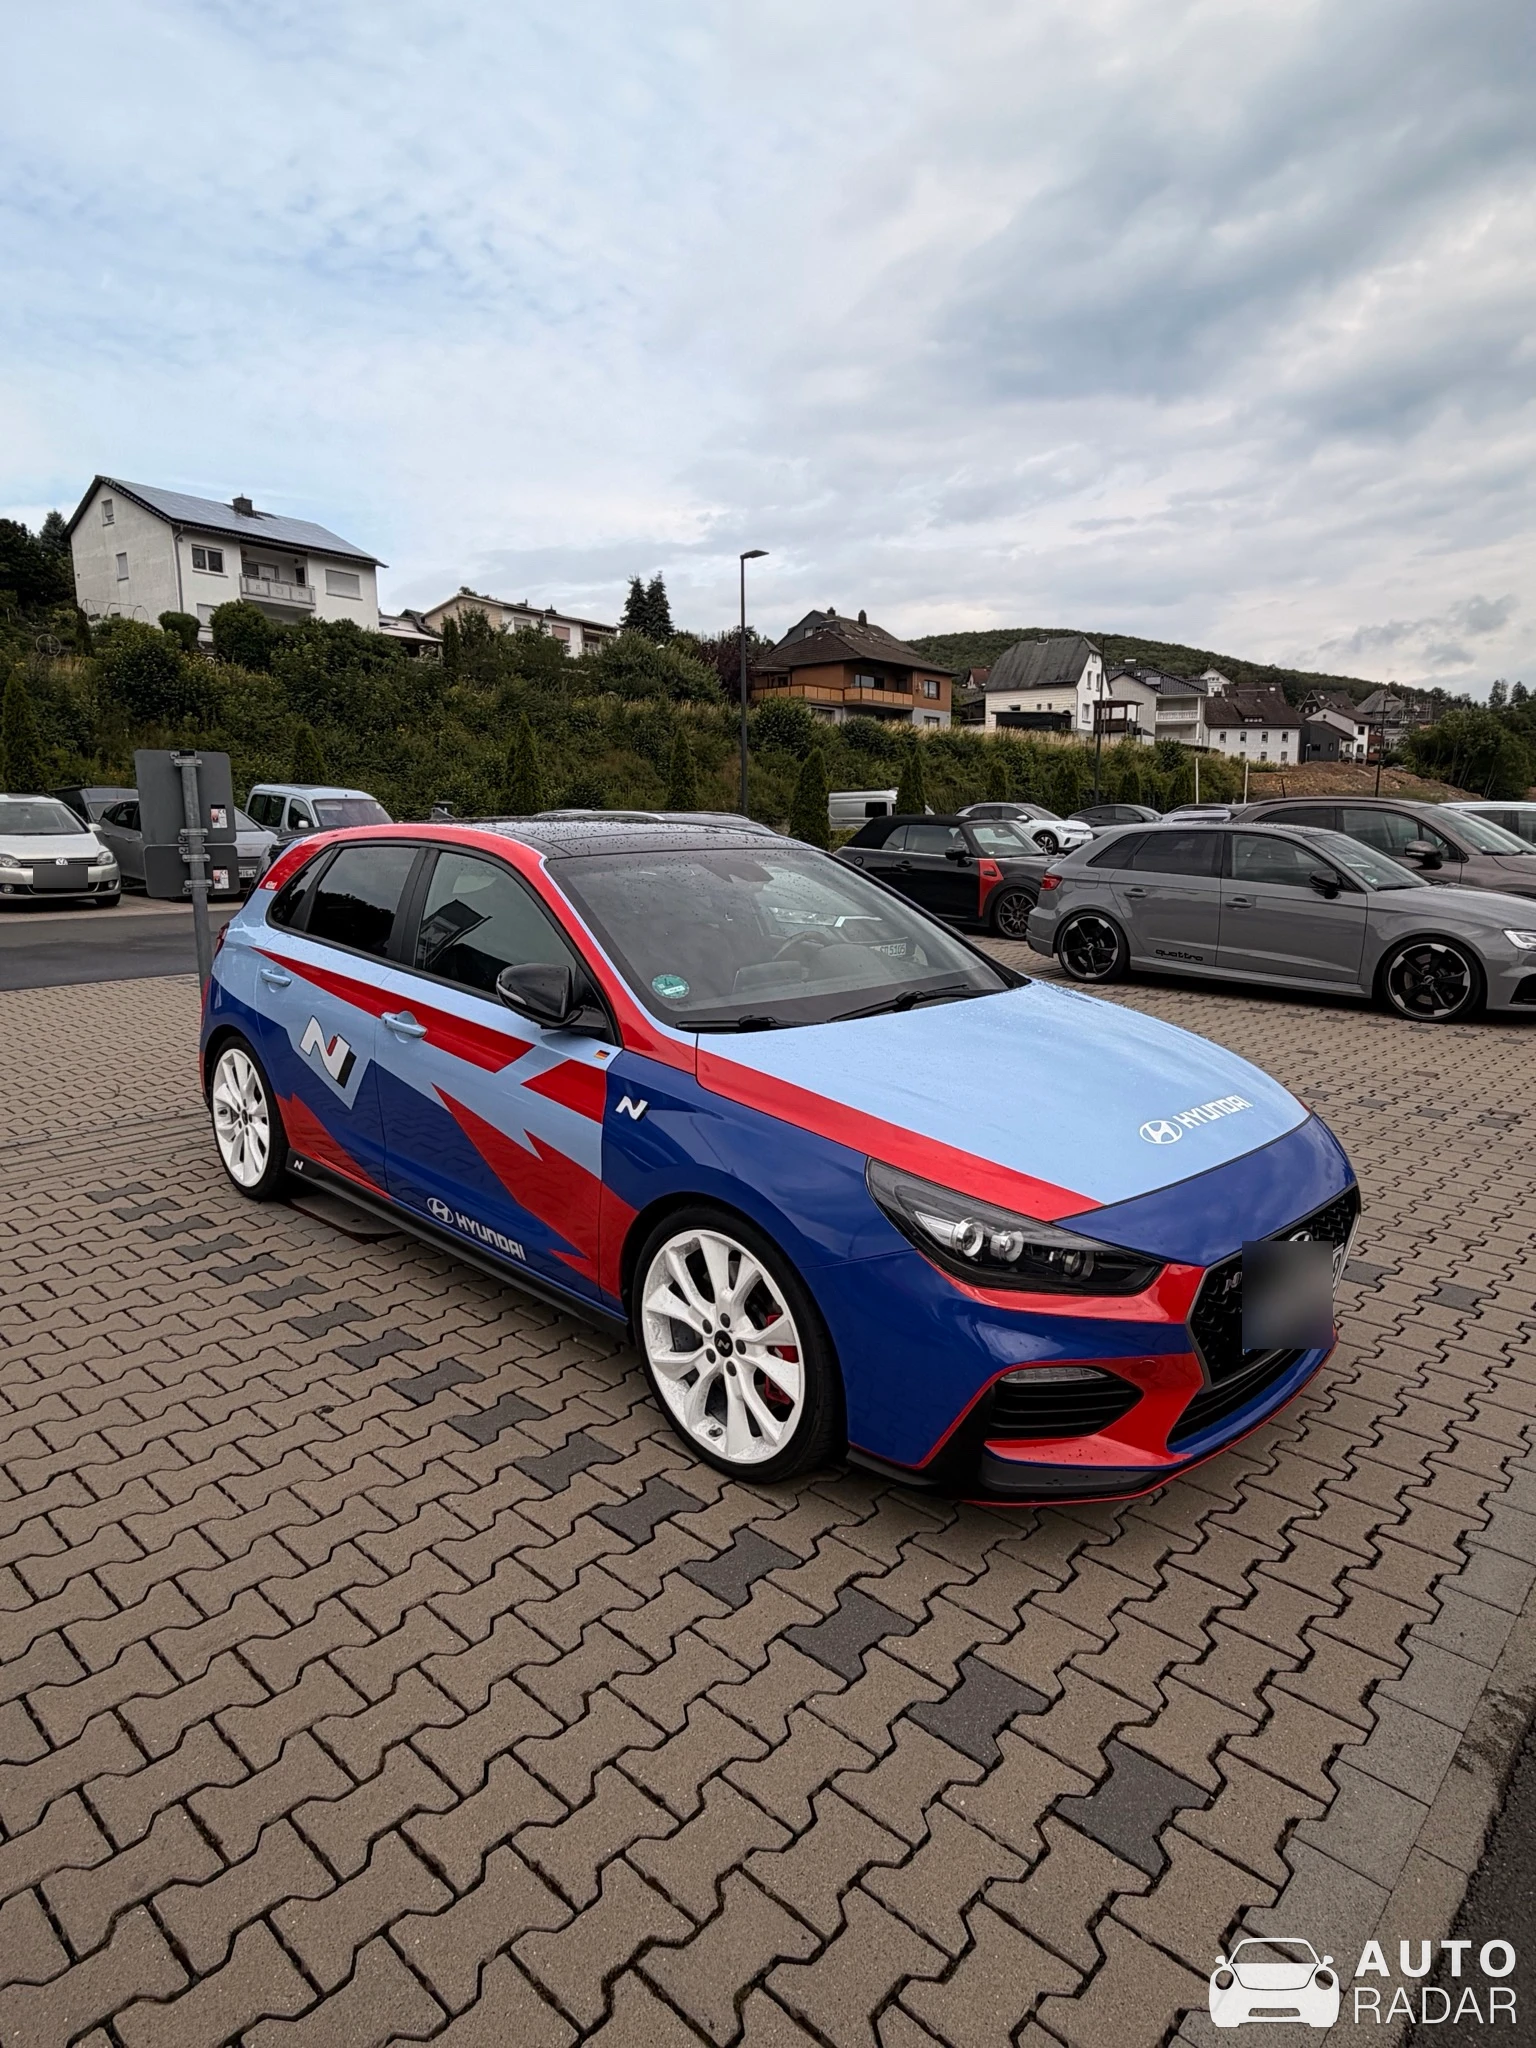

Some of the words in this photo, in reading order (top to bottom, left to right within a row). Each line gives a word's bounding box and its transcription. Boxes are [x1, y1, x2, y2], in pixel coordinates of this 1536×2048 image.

[1155, 949, 1203, 961] quattro
[299, 1014, 352, 1083] N
[615, 1095, 648, 1121] N
[1172, 1095, 1253, 1128] HYUNDAI
[293, 1159, 304, 1171] N
[455, 1212, 526, 1261] HYUNDAI
